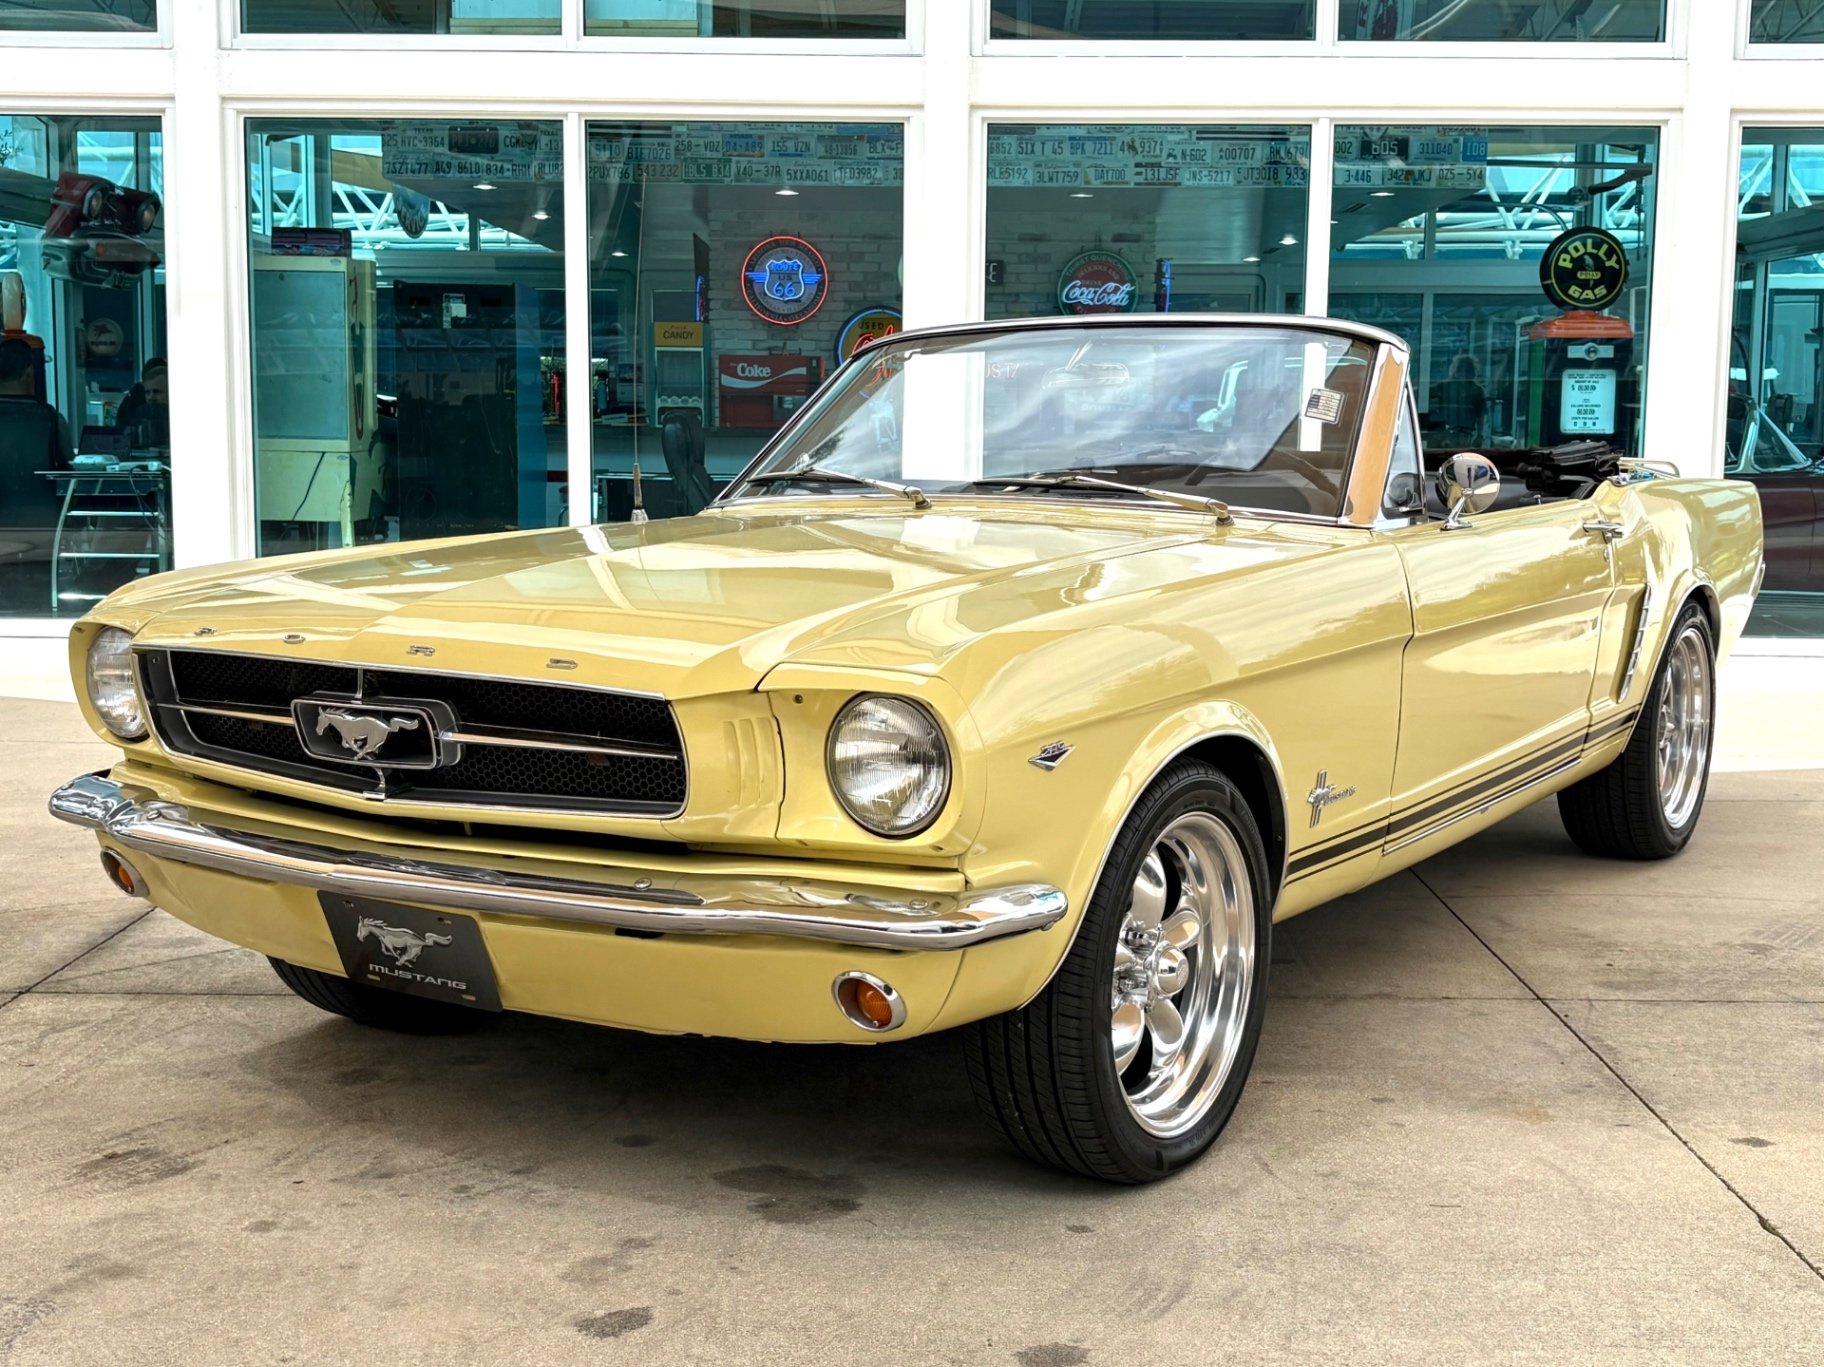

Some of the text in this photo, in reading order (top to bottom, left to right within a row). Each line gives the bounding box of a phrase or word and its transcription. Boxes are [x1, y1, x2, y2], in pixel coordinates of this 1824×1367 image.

[1558, 238, 1620, 270] POLLY
[770, 263, 799, 271] ROUTE
[772, 281, 796, 297] 66
[1062, 280, 1136, 306] Coca-Cola
[1567, 285, 1608, 300] GAS
[858, 321, 884, 330] USED
[663, 330, 695, 340] CANDY
[736, 362, 771, 378] Coke
[369, 963, 467, 990] MUSTANG
